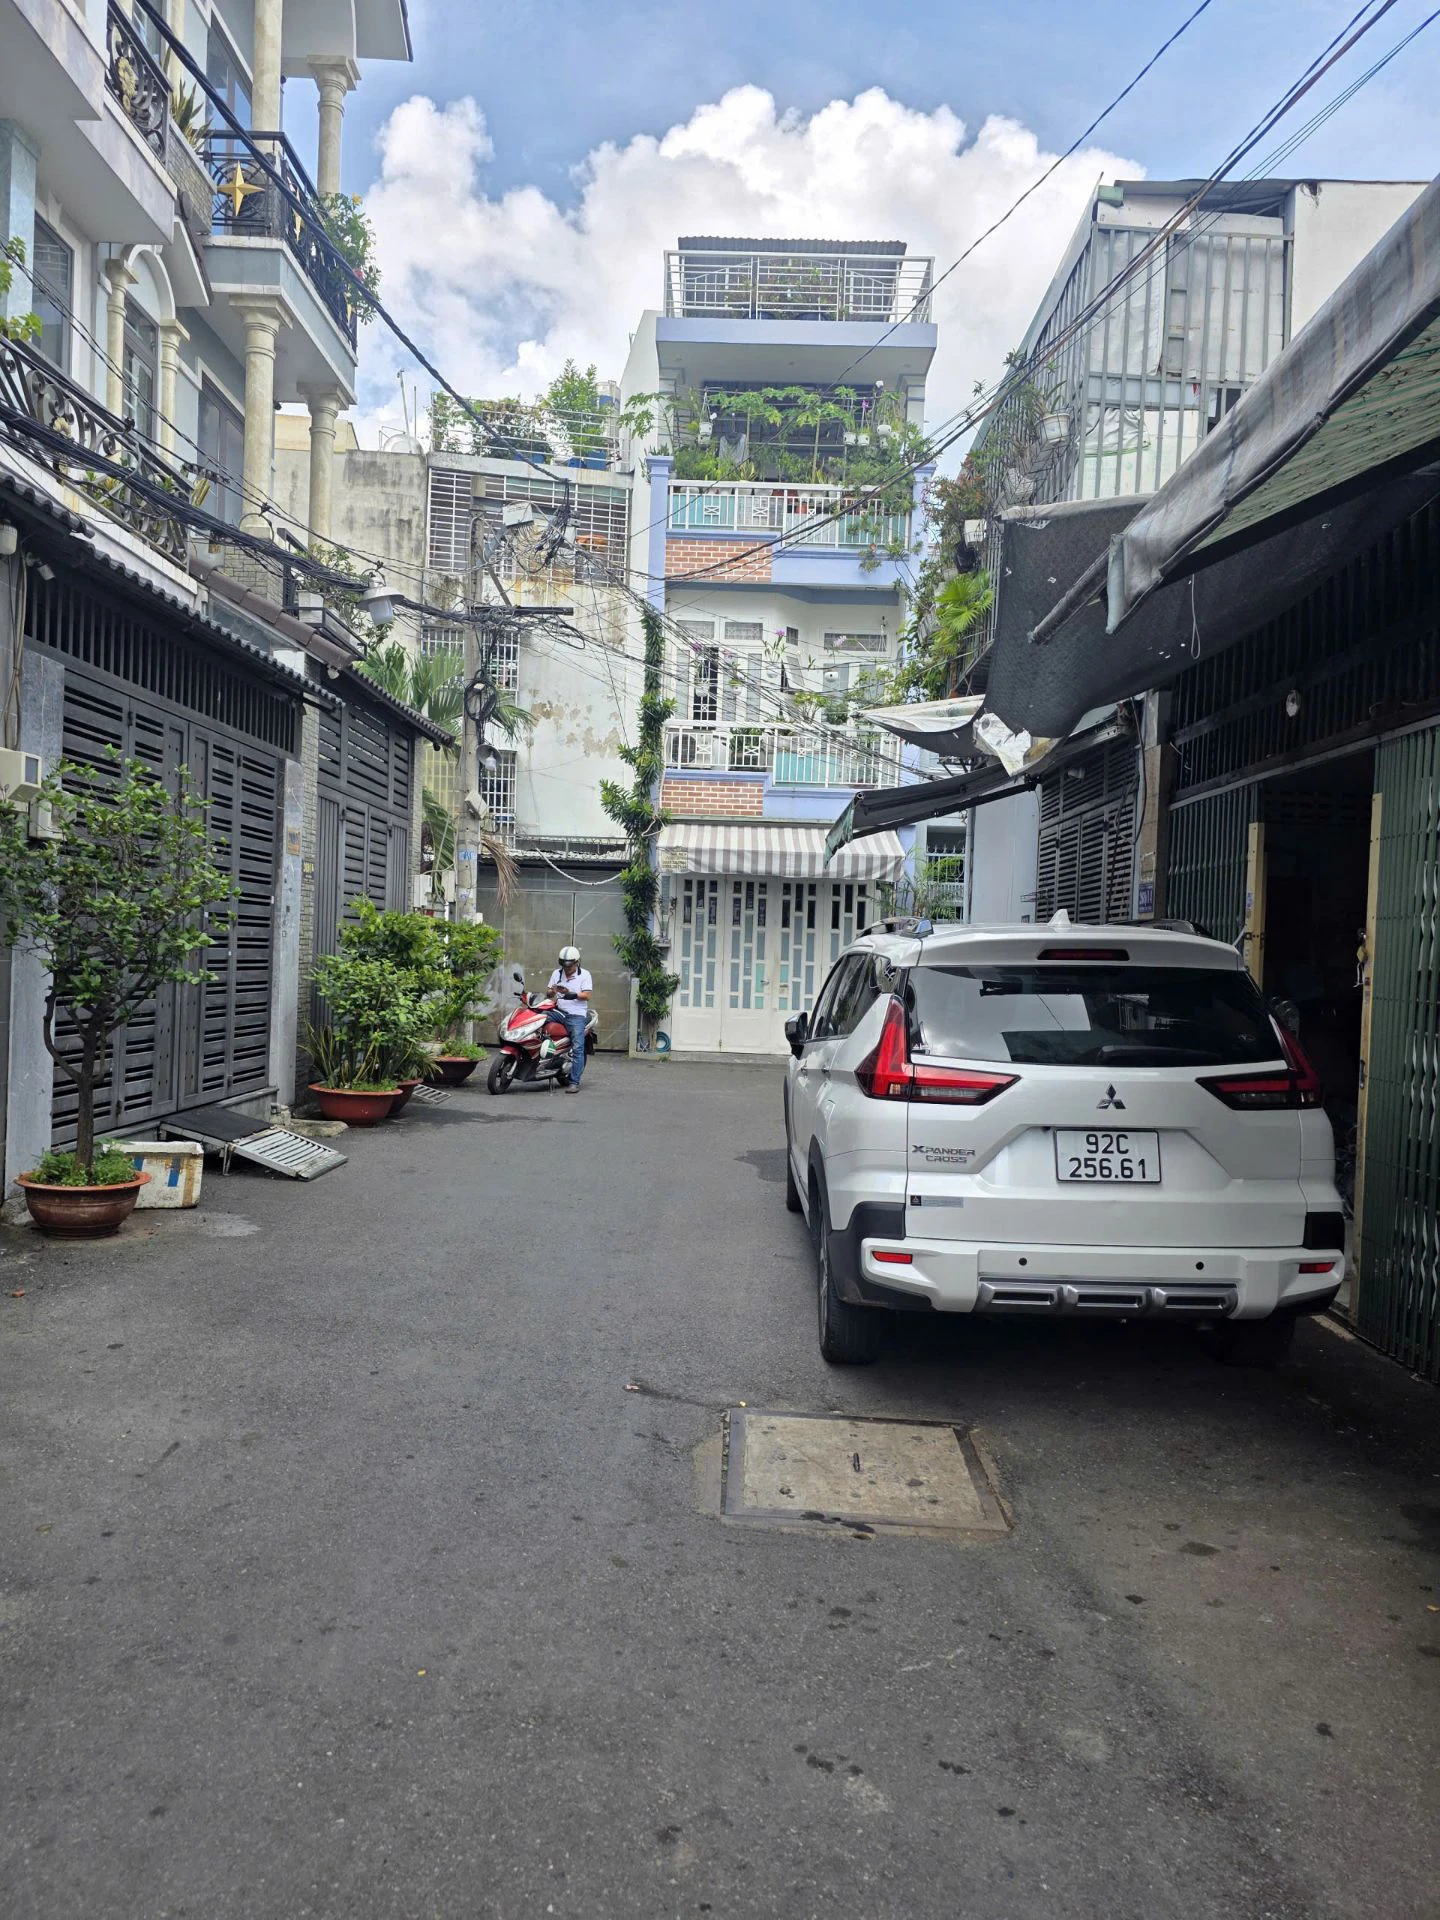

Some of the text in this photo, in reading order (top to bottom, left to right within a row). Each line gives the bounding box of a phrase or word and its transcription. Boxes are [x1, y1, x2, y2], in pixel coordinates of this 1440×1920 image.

[911, 1144, 976, 1156] XPANDER
[1086, 1133, 1129, 1154] 92C
[925, 1155, 967, 1164] CROSS
[1069, 1157, 1146, 1179] 256.61
